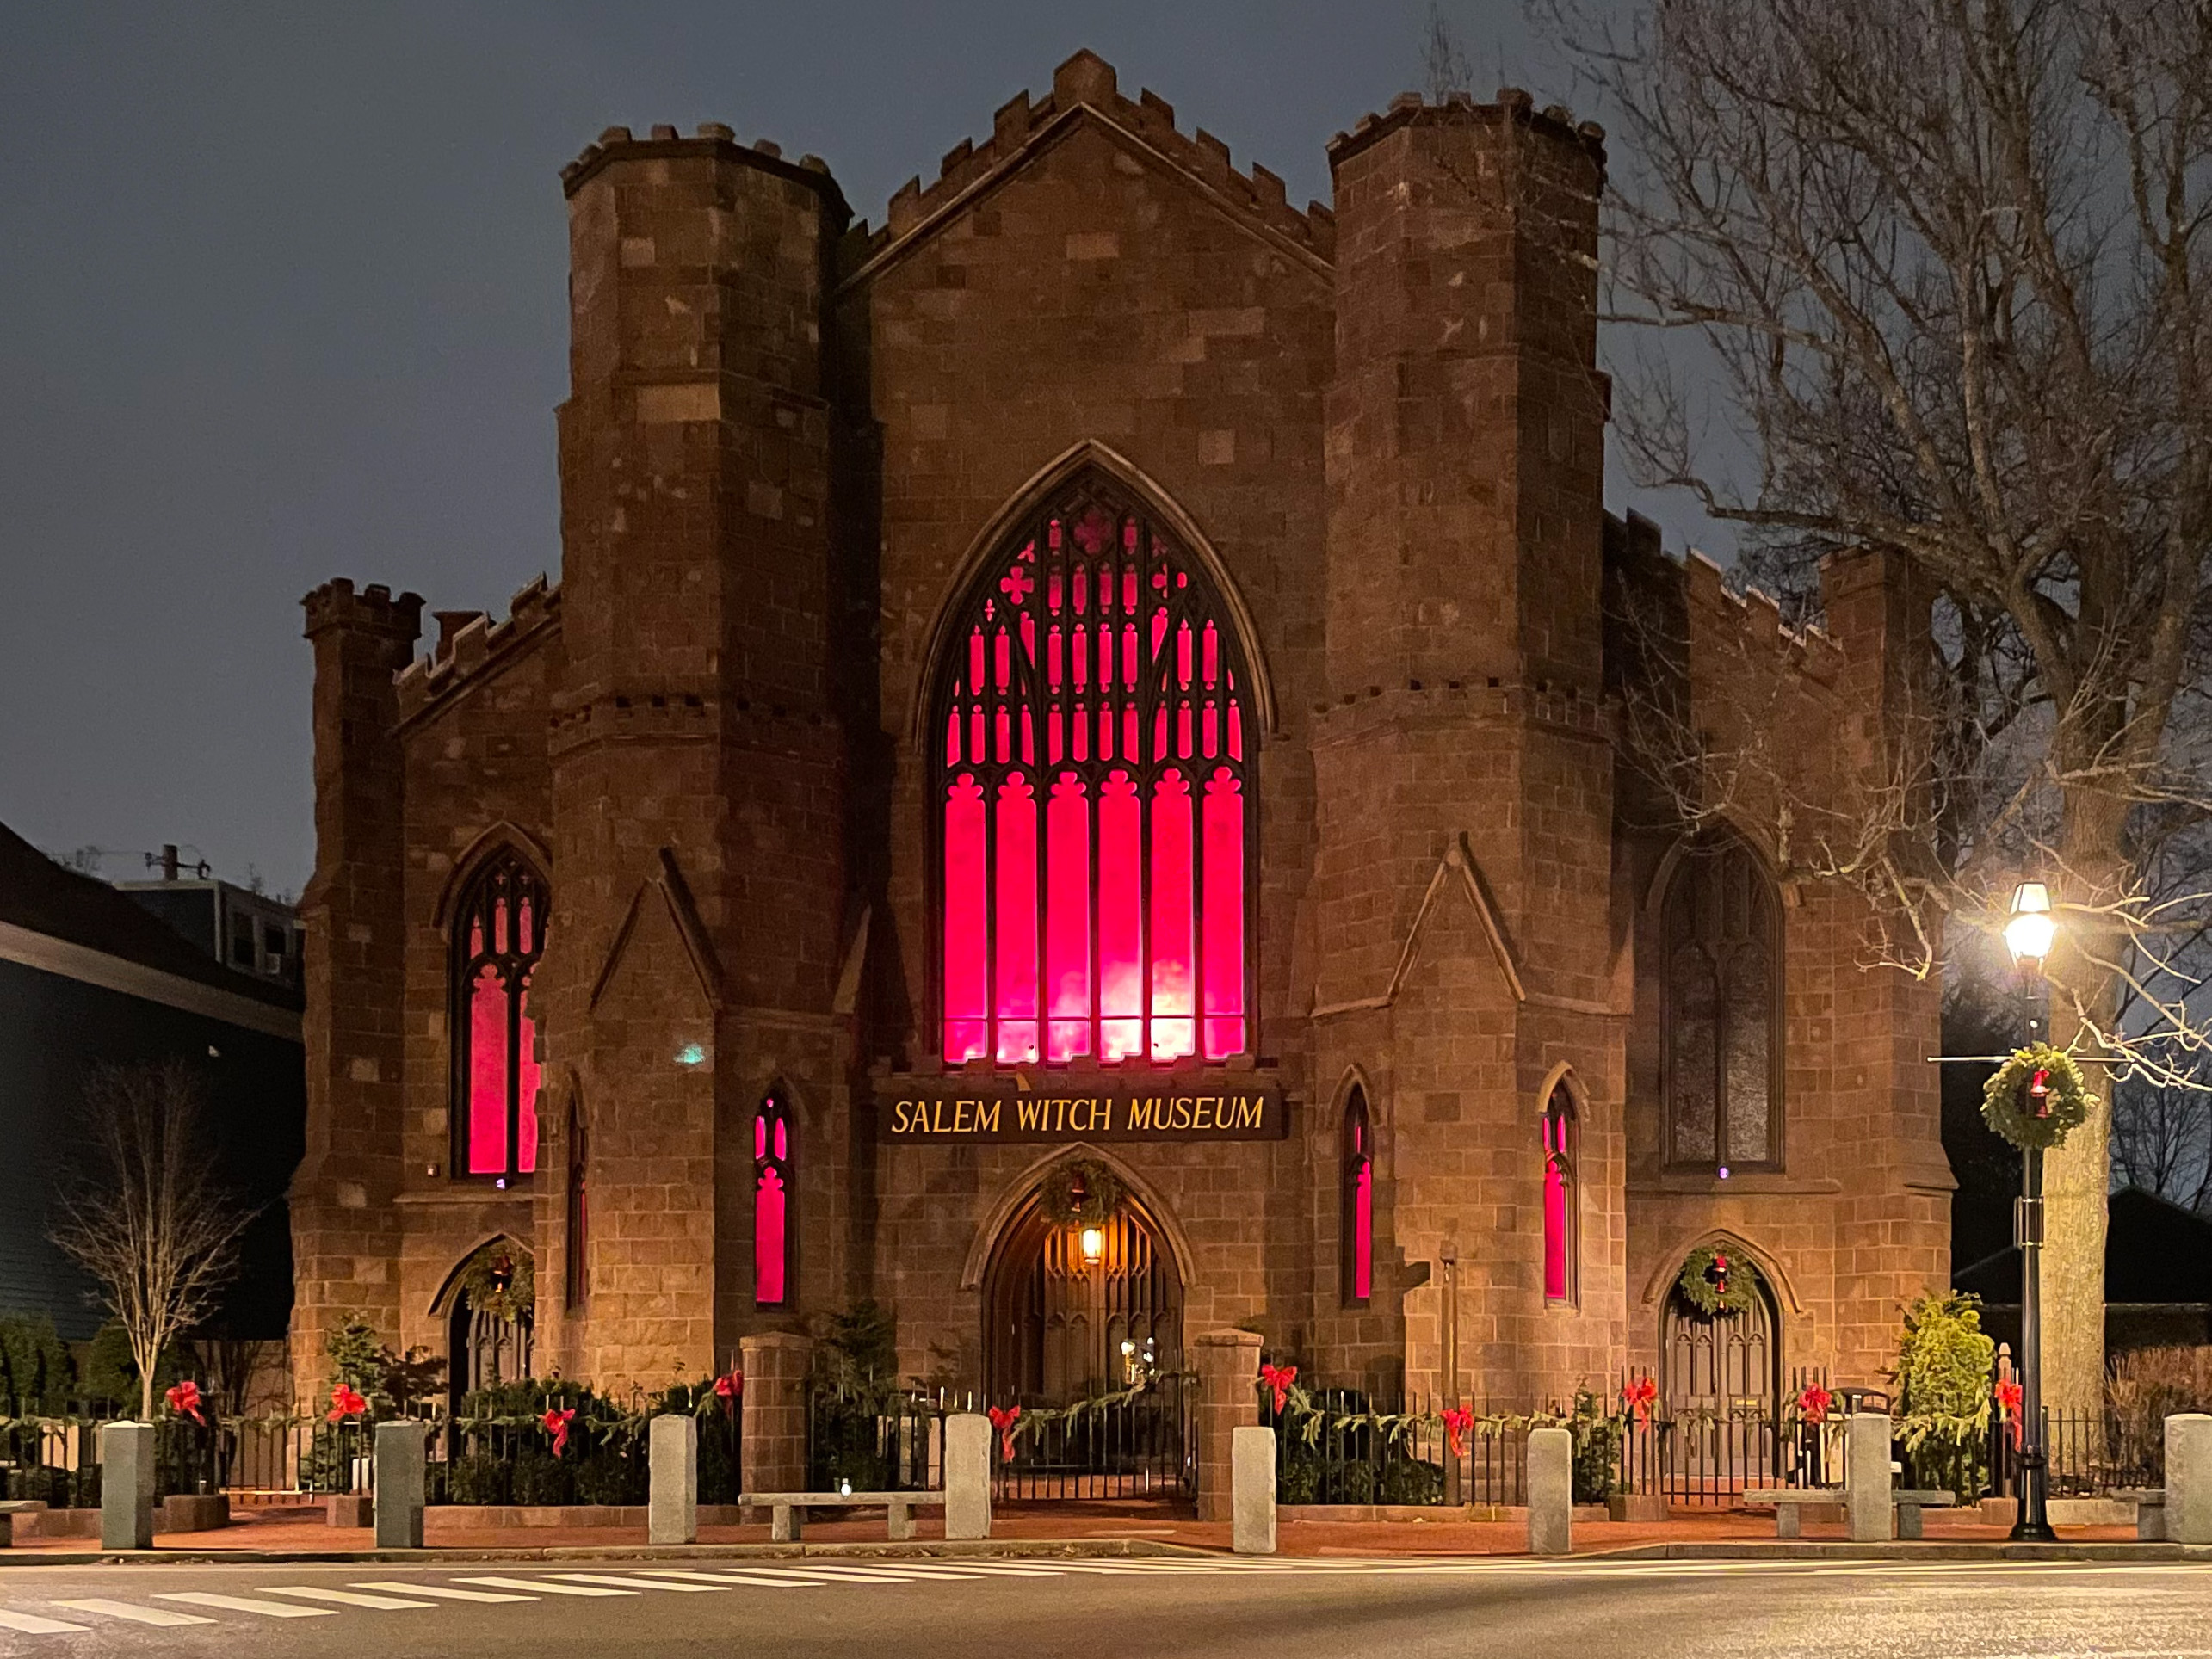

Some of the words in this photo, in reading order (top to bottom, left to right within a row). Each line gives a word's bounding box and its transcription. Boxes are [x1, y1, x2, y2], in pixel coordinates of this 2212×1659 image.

[891, 1100, 1002, 1132] SALEM
[1016, 1098, 1113, 1132] WITCH
[1127, 1096, 1265, 1130] MUSEUM
